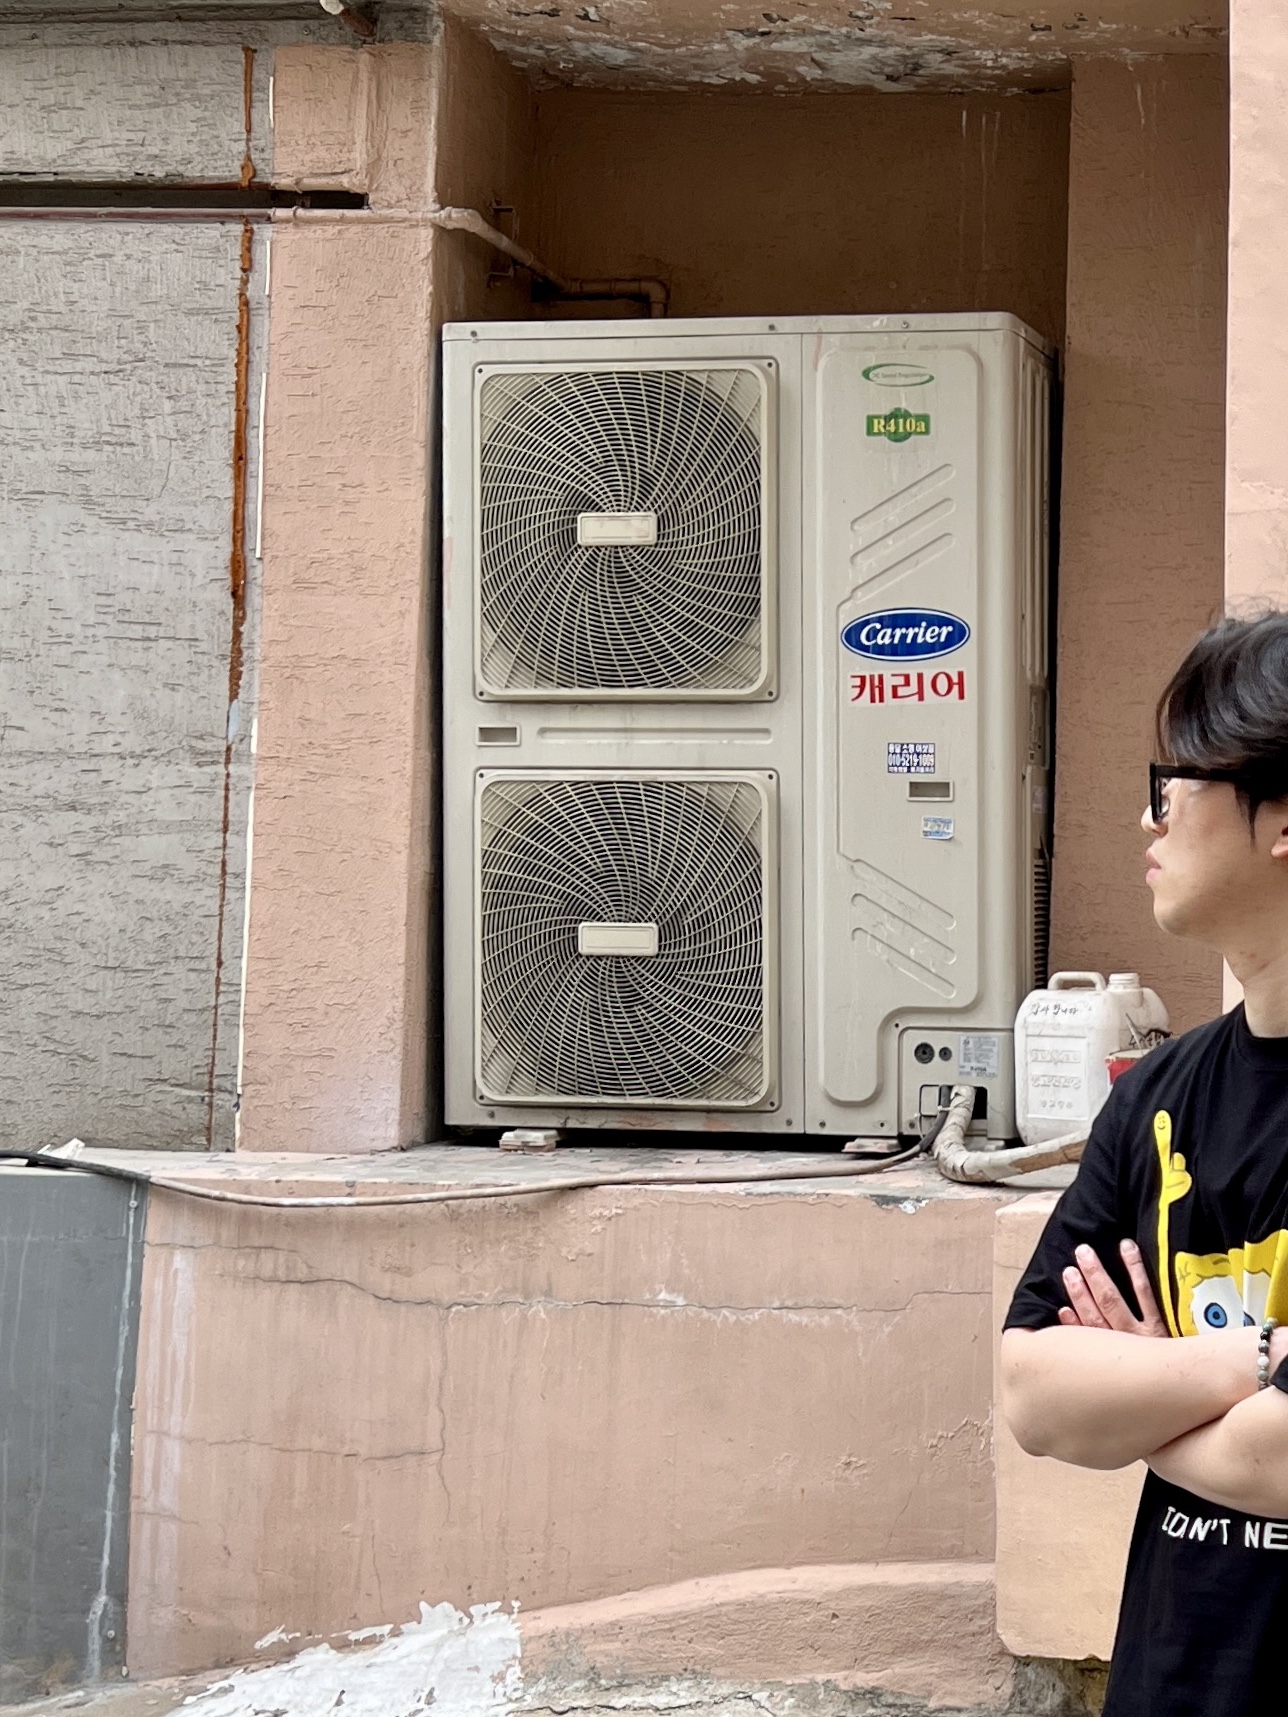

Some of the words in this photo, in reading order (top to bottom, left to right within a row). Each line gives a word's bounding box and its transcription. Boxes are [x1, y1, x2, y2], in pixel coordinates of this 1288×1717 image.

[873, 418, 926, 433] R410a
[860, 621, 954, 646] Carrier
[850, 670, 965, 704] 캐리어
